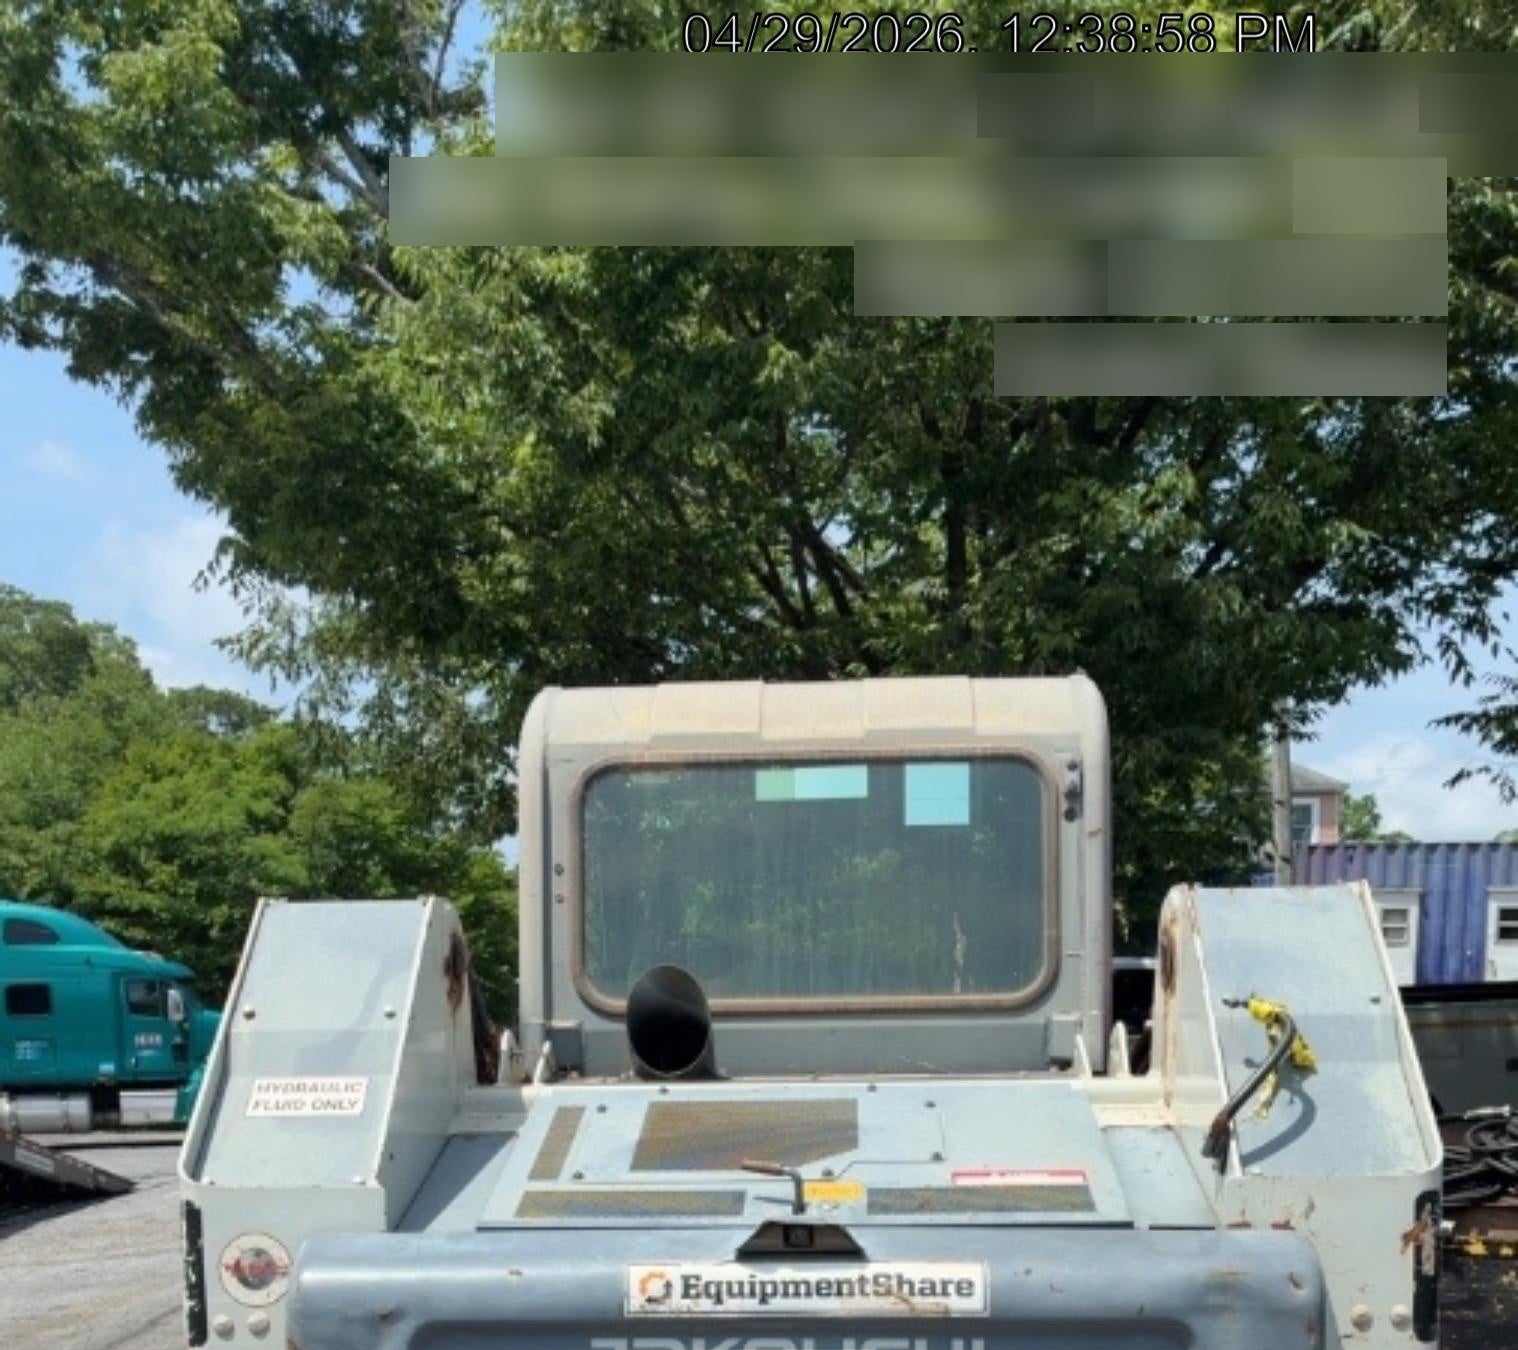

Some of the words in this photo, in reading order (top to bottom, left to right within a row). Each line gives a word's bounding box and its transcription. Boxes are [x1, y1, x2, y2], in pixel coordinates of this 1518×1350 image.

[256, 1081, 363, 1093] HYDRAULIC
[251, 1100, 307, 1112] FLUID
[310, 1098, 358, 1111] ONLY
[680, 1273, 976, 1305] EquipmentShare
